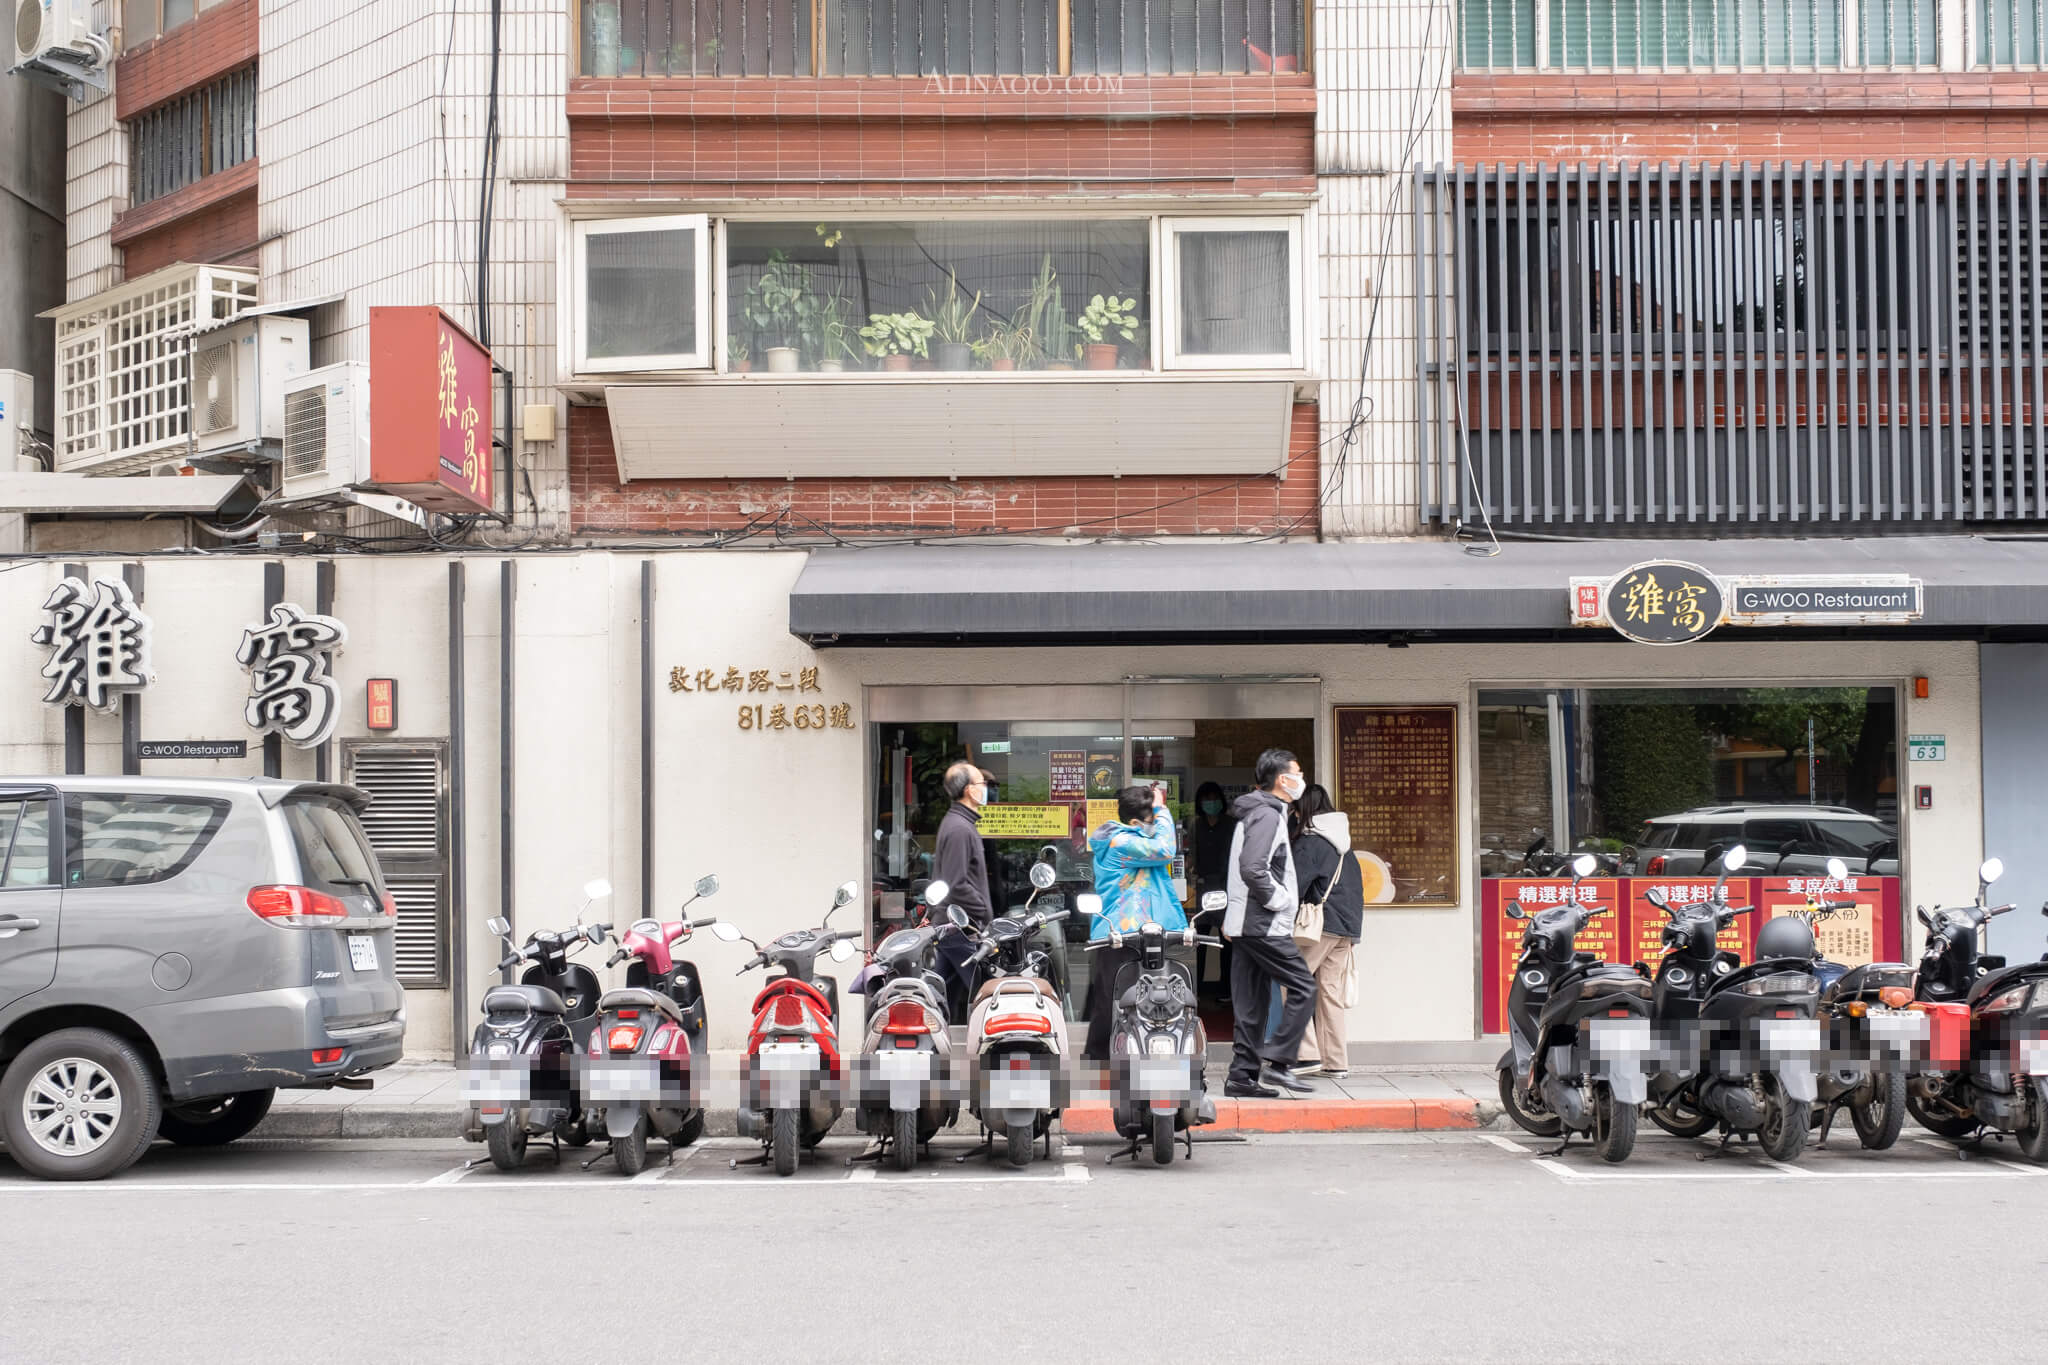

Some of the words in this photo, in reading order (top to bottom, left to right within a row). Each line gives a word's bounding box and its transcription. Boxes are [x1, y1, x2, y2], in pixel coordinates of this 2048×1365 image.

[1620, 573, 1707, 633] 雞窩
[1744, 592, 1809, 608] G-WOO
[1815, 591, 1908, 607] Restaurant
[31, 576, 347, 749] 雞窩
[668, 665, 823, 693] 敦化南路二段
[737, 702, 856, 730] 81巷63號
[142, 745, 181, 756] G-WOO
[183, 744, 239, 756] Restaurant
[1917, 747, 1937, 759] 63
[1518, 885, 1598, 903] 精選料理
[1787, 878, 1858, 894] 宴席菜單
